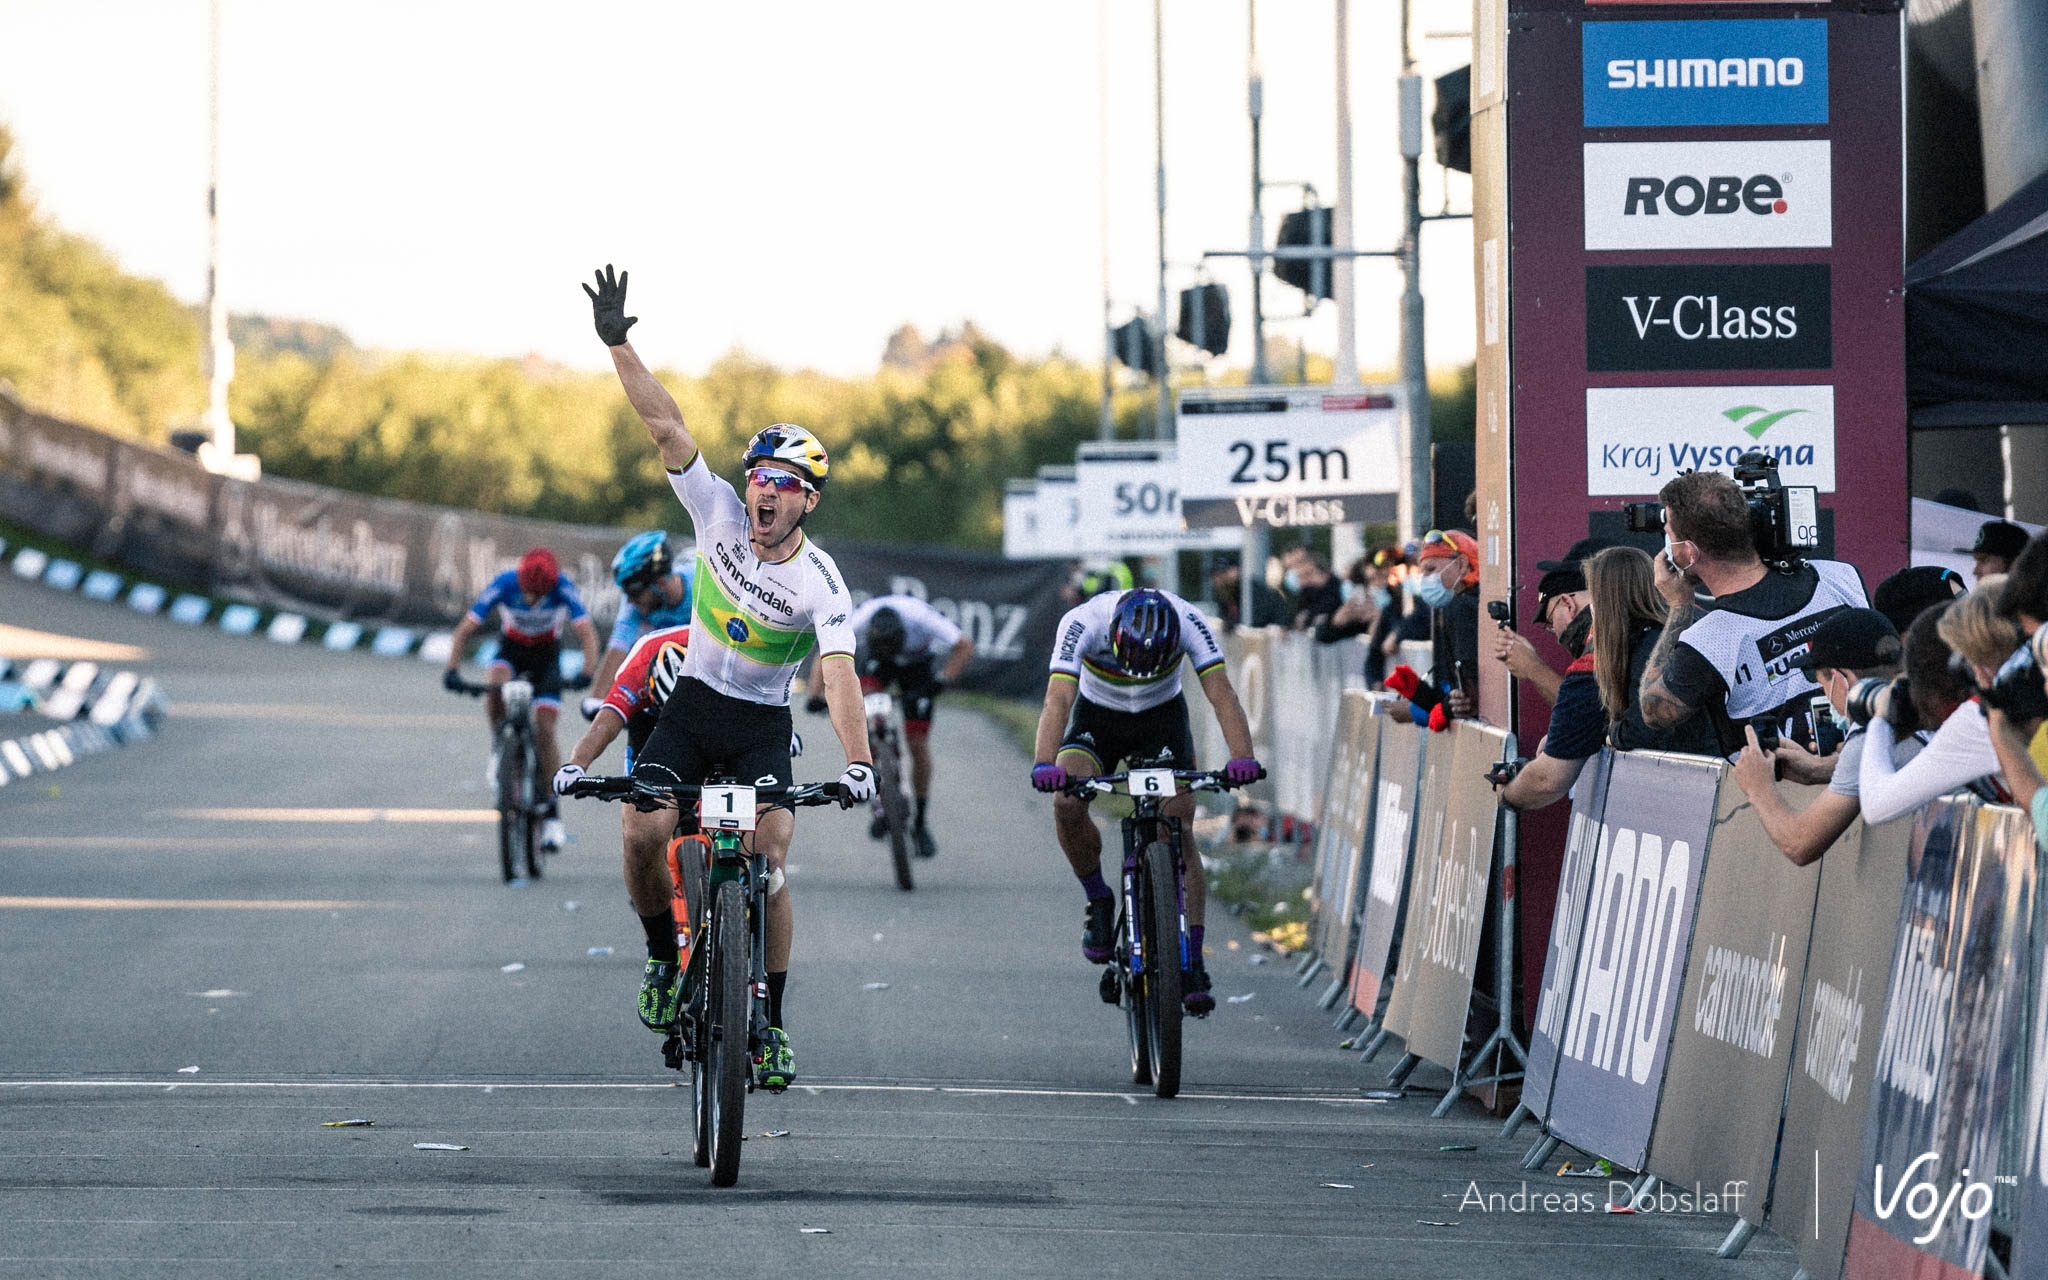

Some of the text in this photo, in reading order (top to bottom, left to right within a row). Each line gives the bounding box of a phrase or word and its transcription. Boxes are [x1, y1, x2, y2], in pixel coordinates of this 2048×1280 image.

[1607, 57, 1804, 89] SHIMANO
[1623, 295, 1798, 340] V-Class
[1228, 439, 1350, 483] 25m
[1602, 442, 1815, 476] Kraj Vysona
[1235, 495, 1346, 528] V-Class
[716, 542, 794, 617] cannondale
[808, 551, 839, 595] cannondale
[720, 792, 734, 813] 1
[1144, 776, 1159, 792] 6
[1694, 931, 1789, 1060] cannondale
